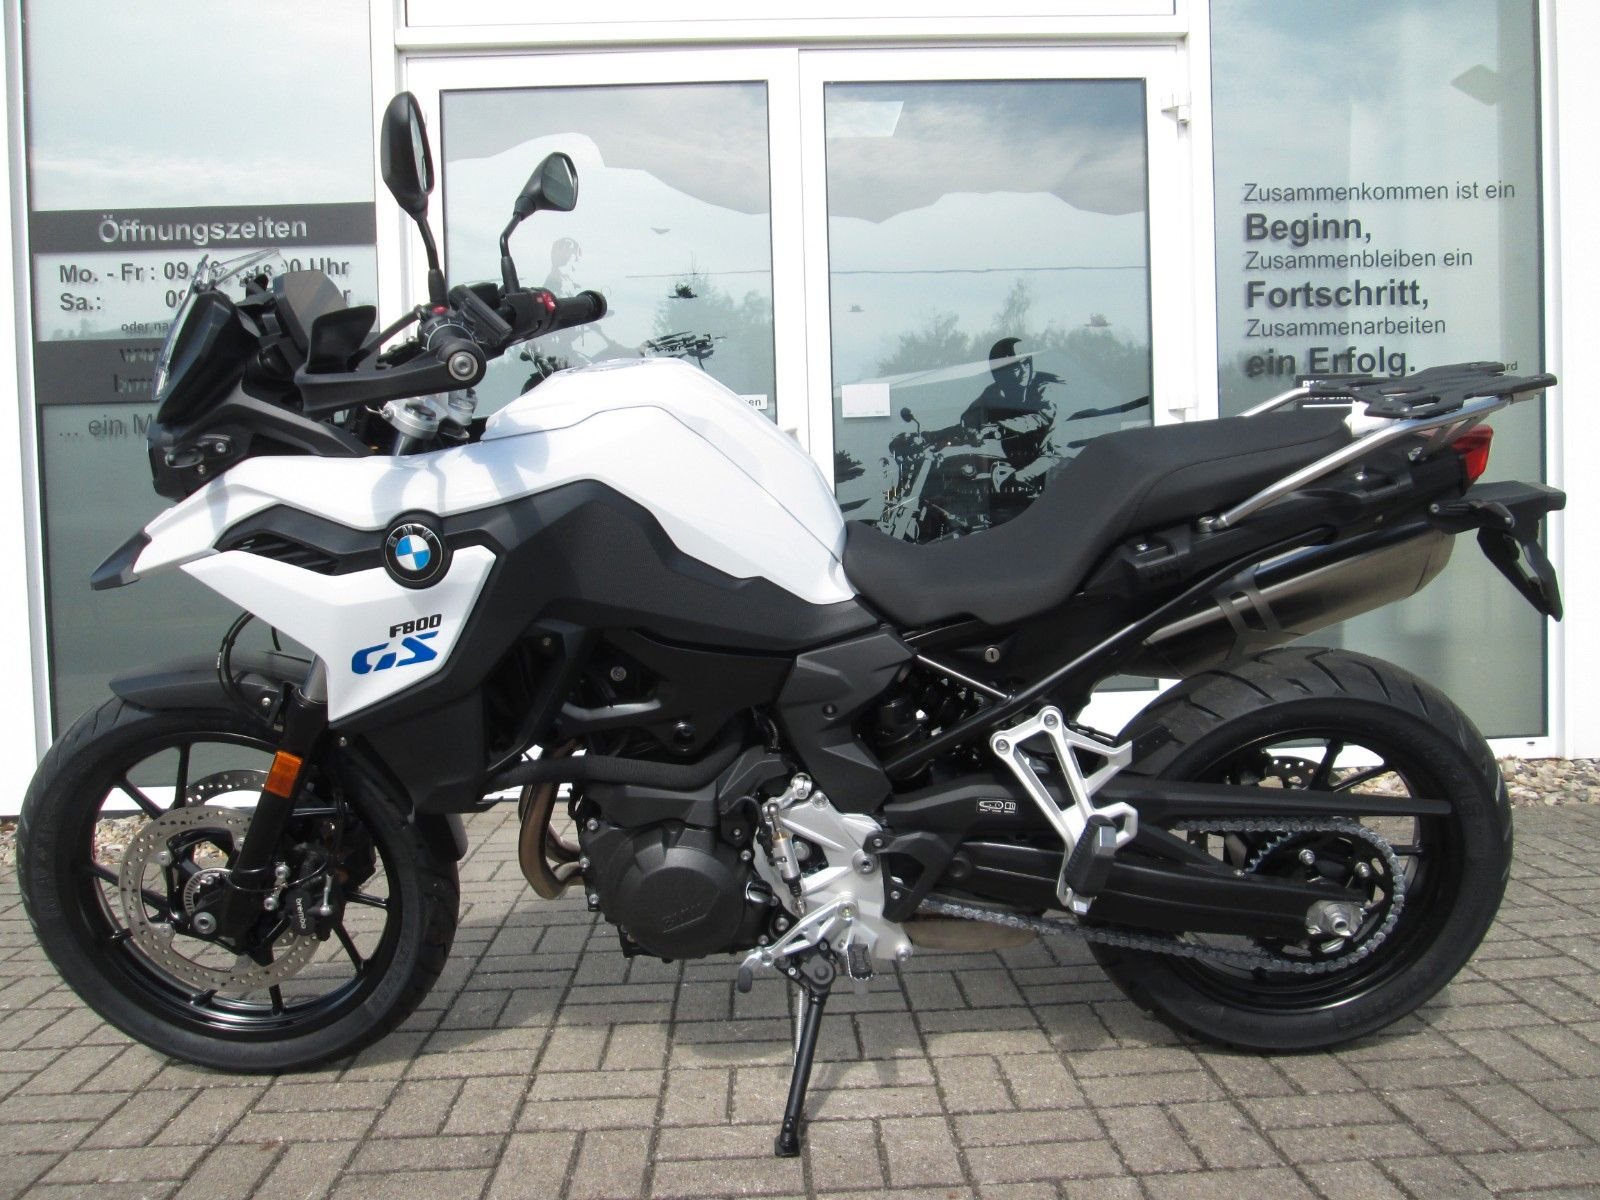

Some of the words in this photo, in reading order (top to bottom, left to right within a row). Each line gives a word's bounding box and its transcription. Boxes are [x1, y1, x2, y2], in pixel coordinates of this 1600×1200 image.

[1243, 182, 1449, 202] Zusammenkommen
[1456, 180, 1478, 199] ist
[1485, 180, 1515, 199] ein
[99, 214, 308, 246] Öffnungszeiten
[1246, 212, 1372, 247] Beginn,
[59, 264, 99, 283] Mo.
[310, 257, 350, 276] Uhr
[1245, 248, 1436, 270] Zusammenbleiben
[1443, 248, 1473, 266] ein
[1246, 279, 1429, 308] Fortschritt,
[121, 321, 150, 332] oder
[1246, 317, 1446, 338] Zusammenarbeiten
[1246, 348, 1296, 377] ein
[1309, 346, 1416, 377] Erfolg.
[88, 414, 124, 437] ein
[389, 613, 442, 639] F800
[351, 630, 440, 675] GS
